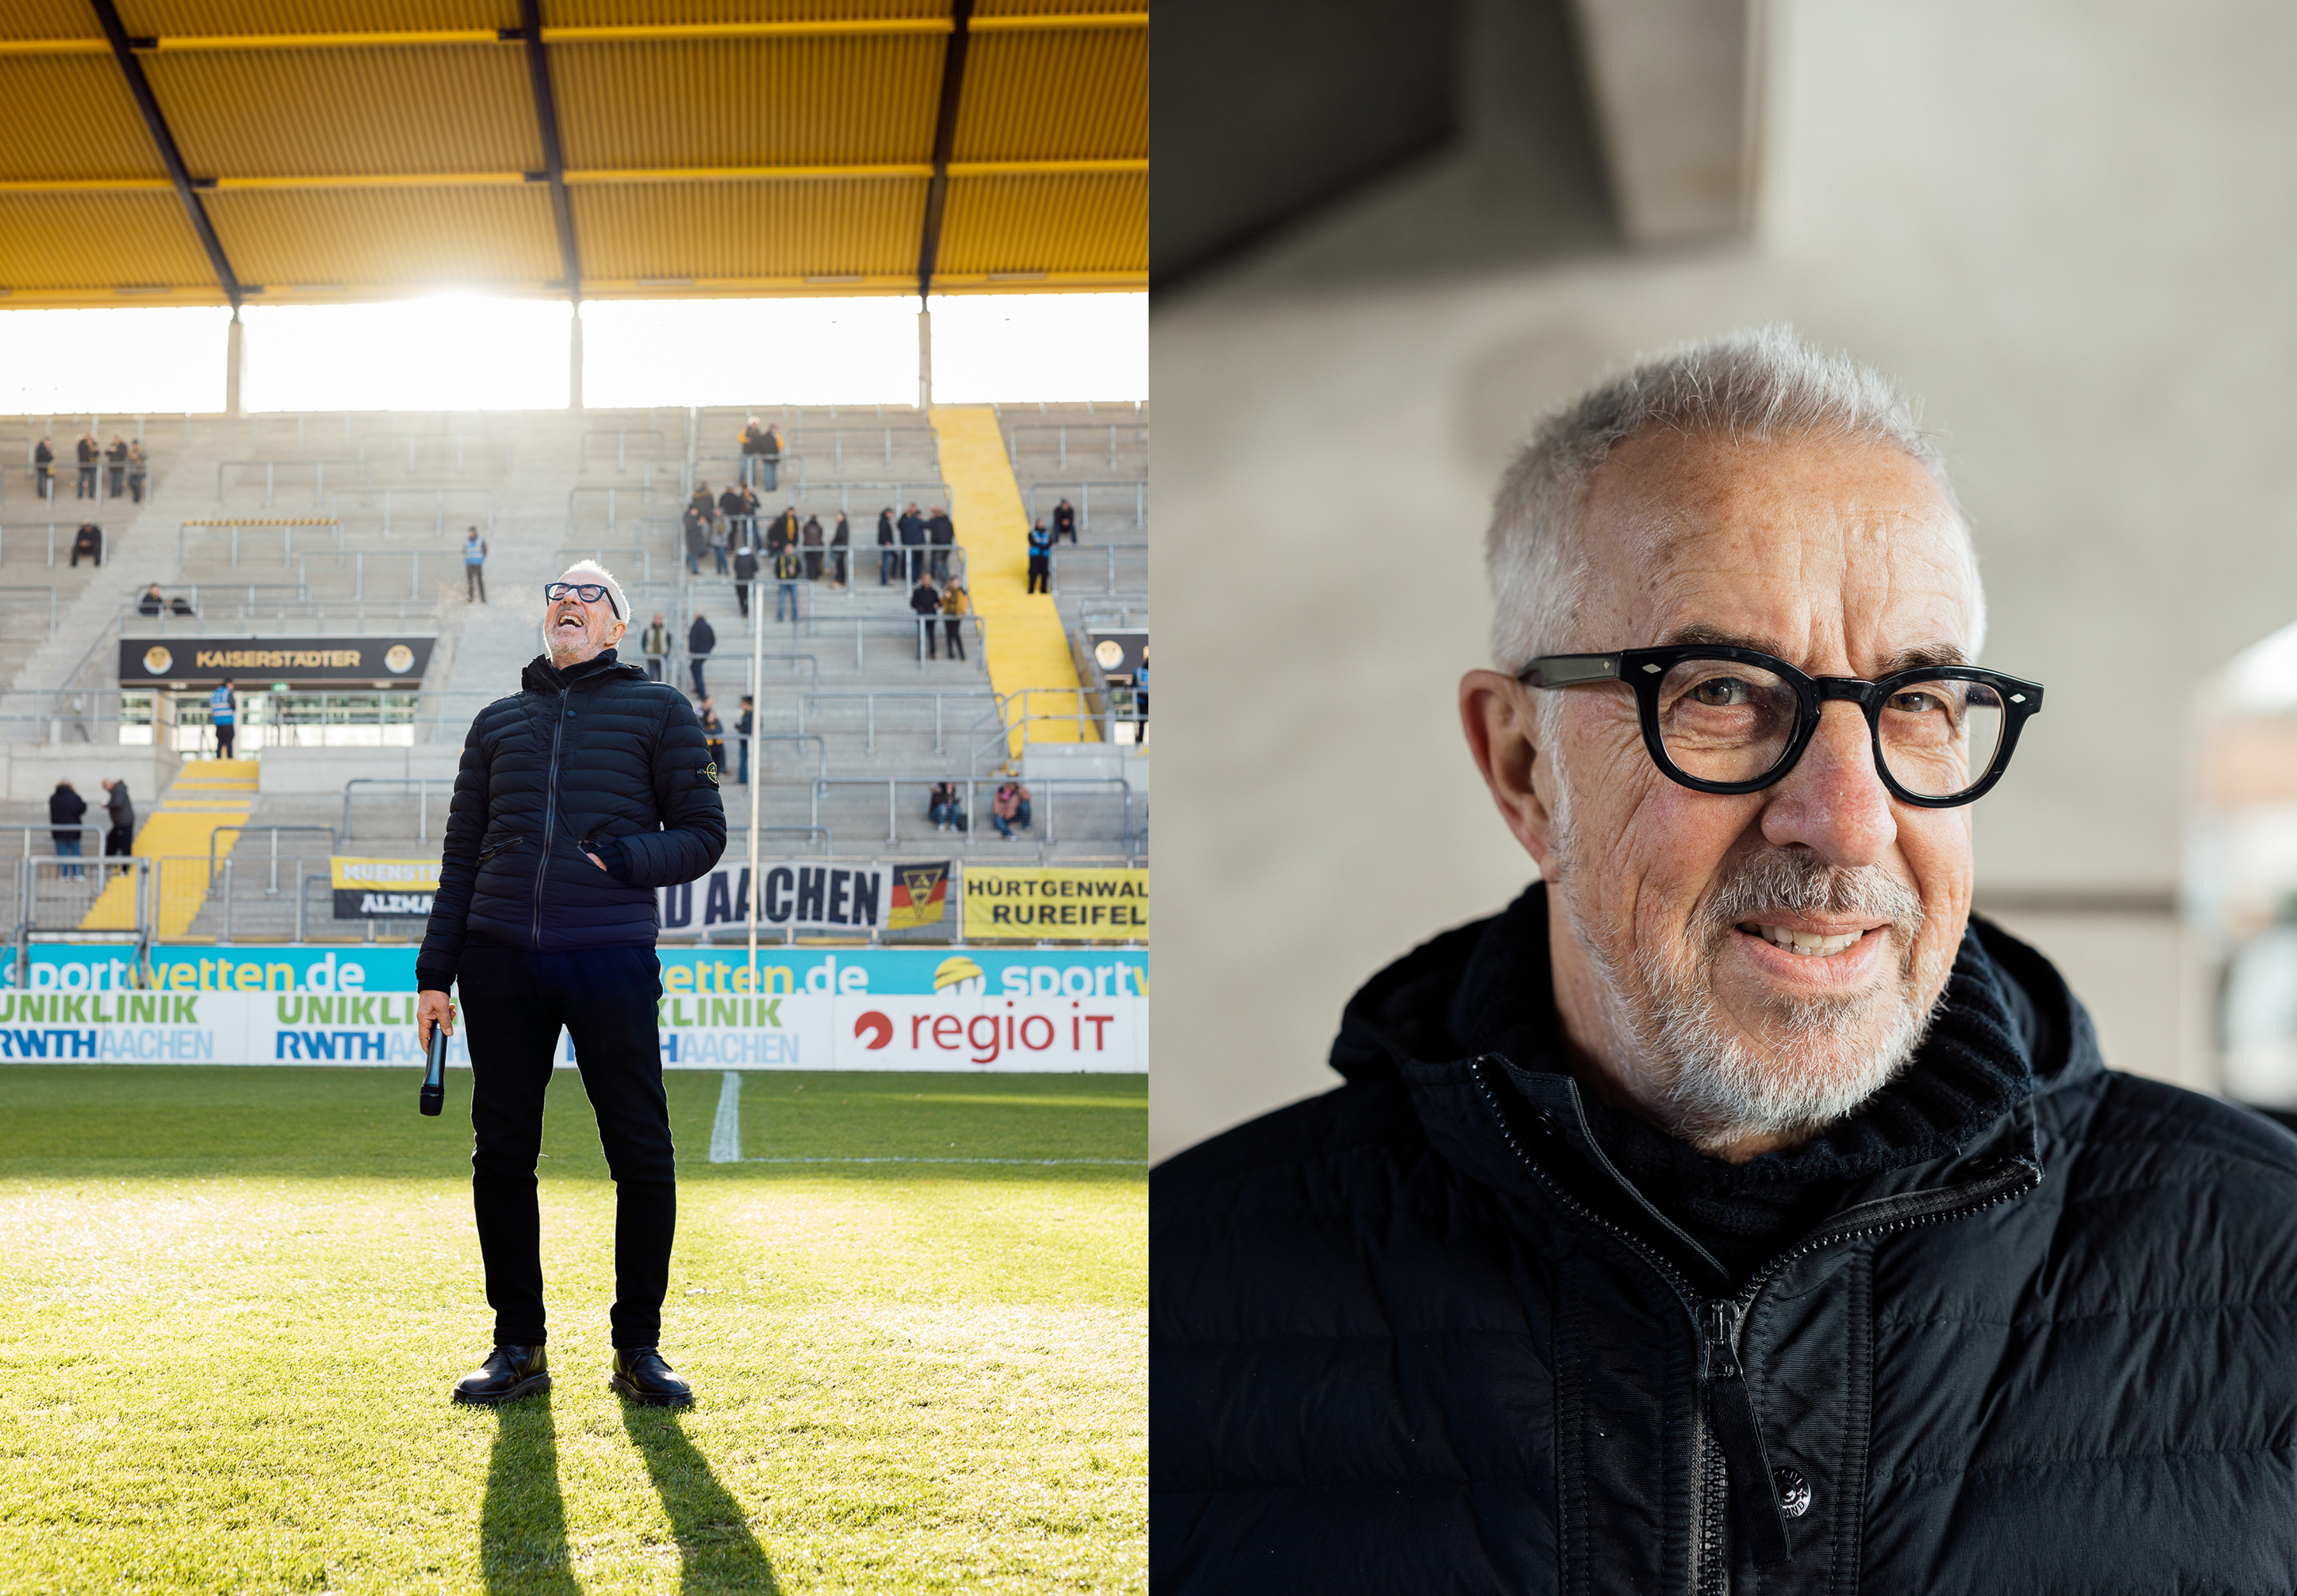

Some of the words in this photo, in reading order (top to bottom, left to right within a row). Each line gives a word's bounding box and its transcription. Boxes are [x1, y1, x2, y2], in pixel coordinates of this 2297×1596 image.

[196, 649, 361, 668] KAISERSTÄDTER
[704, 866, 880, 926] AACHEN
[968, 876, 1148, 898] HÜRTGENWAL
[993, 905, 1146, 925] RUREIFEL
[661, 956, 870, 994] etten.de
[278, 997, 460, 1024] UNIKLI
[276, 1031, 385, 1059] RWTH
[912, 1000, 1055, 1063] regio
